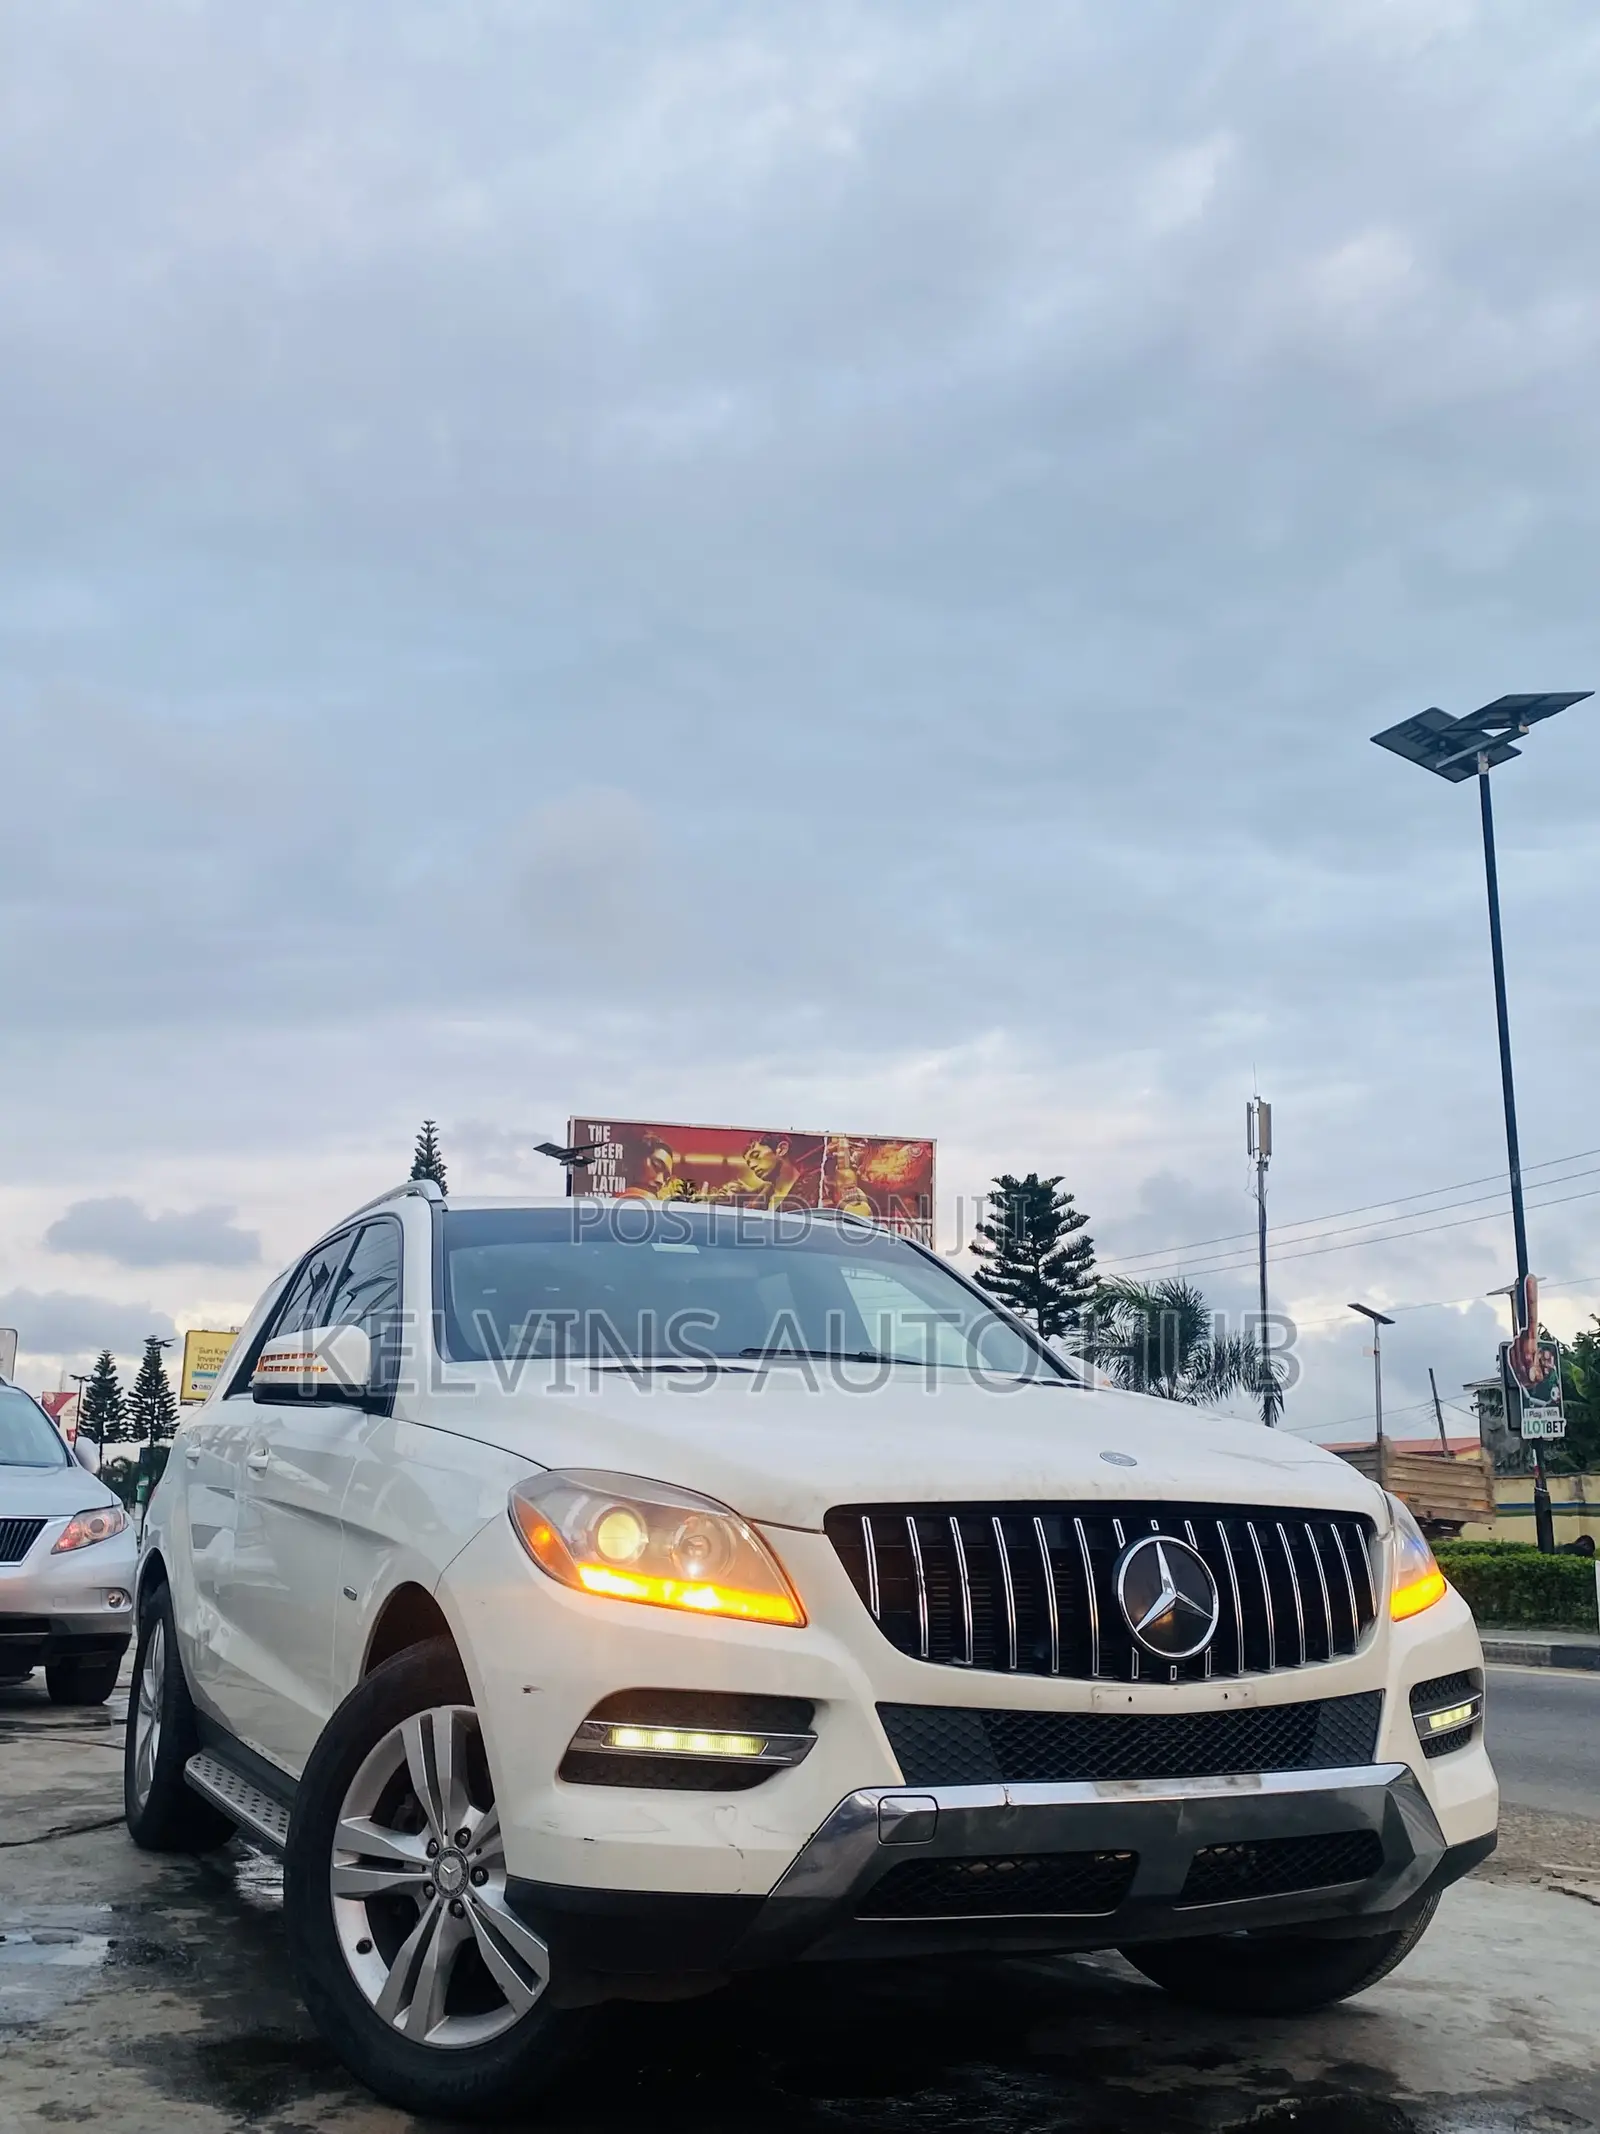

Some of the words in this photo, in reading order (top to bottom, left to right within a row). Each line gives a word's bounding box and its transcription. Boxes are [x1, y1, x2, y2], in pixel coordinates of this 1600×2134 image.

[587, 1124, 611, 1143] THE
[593, 1142, 624, 1160] BEER
[587, 1159, 616, 1176] WITH
[592, 1175, 626, 1193] LATIN
[1530, 1410, 1541, 1419] Play
[1523, 1420, 1565, 1435] iLOTBET
